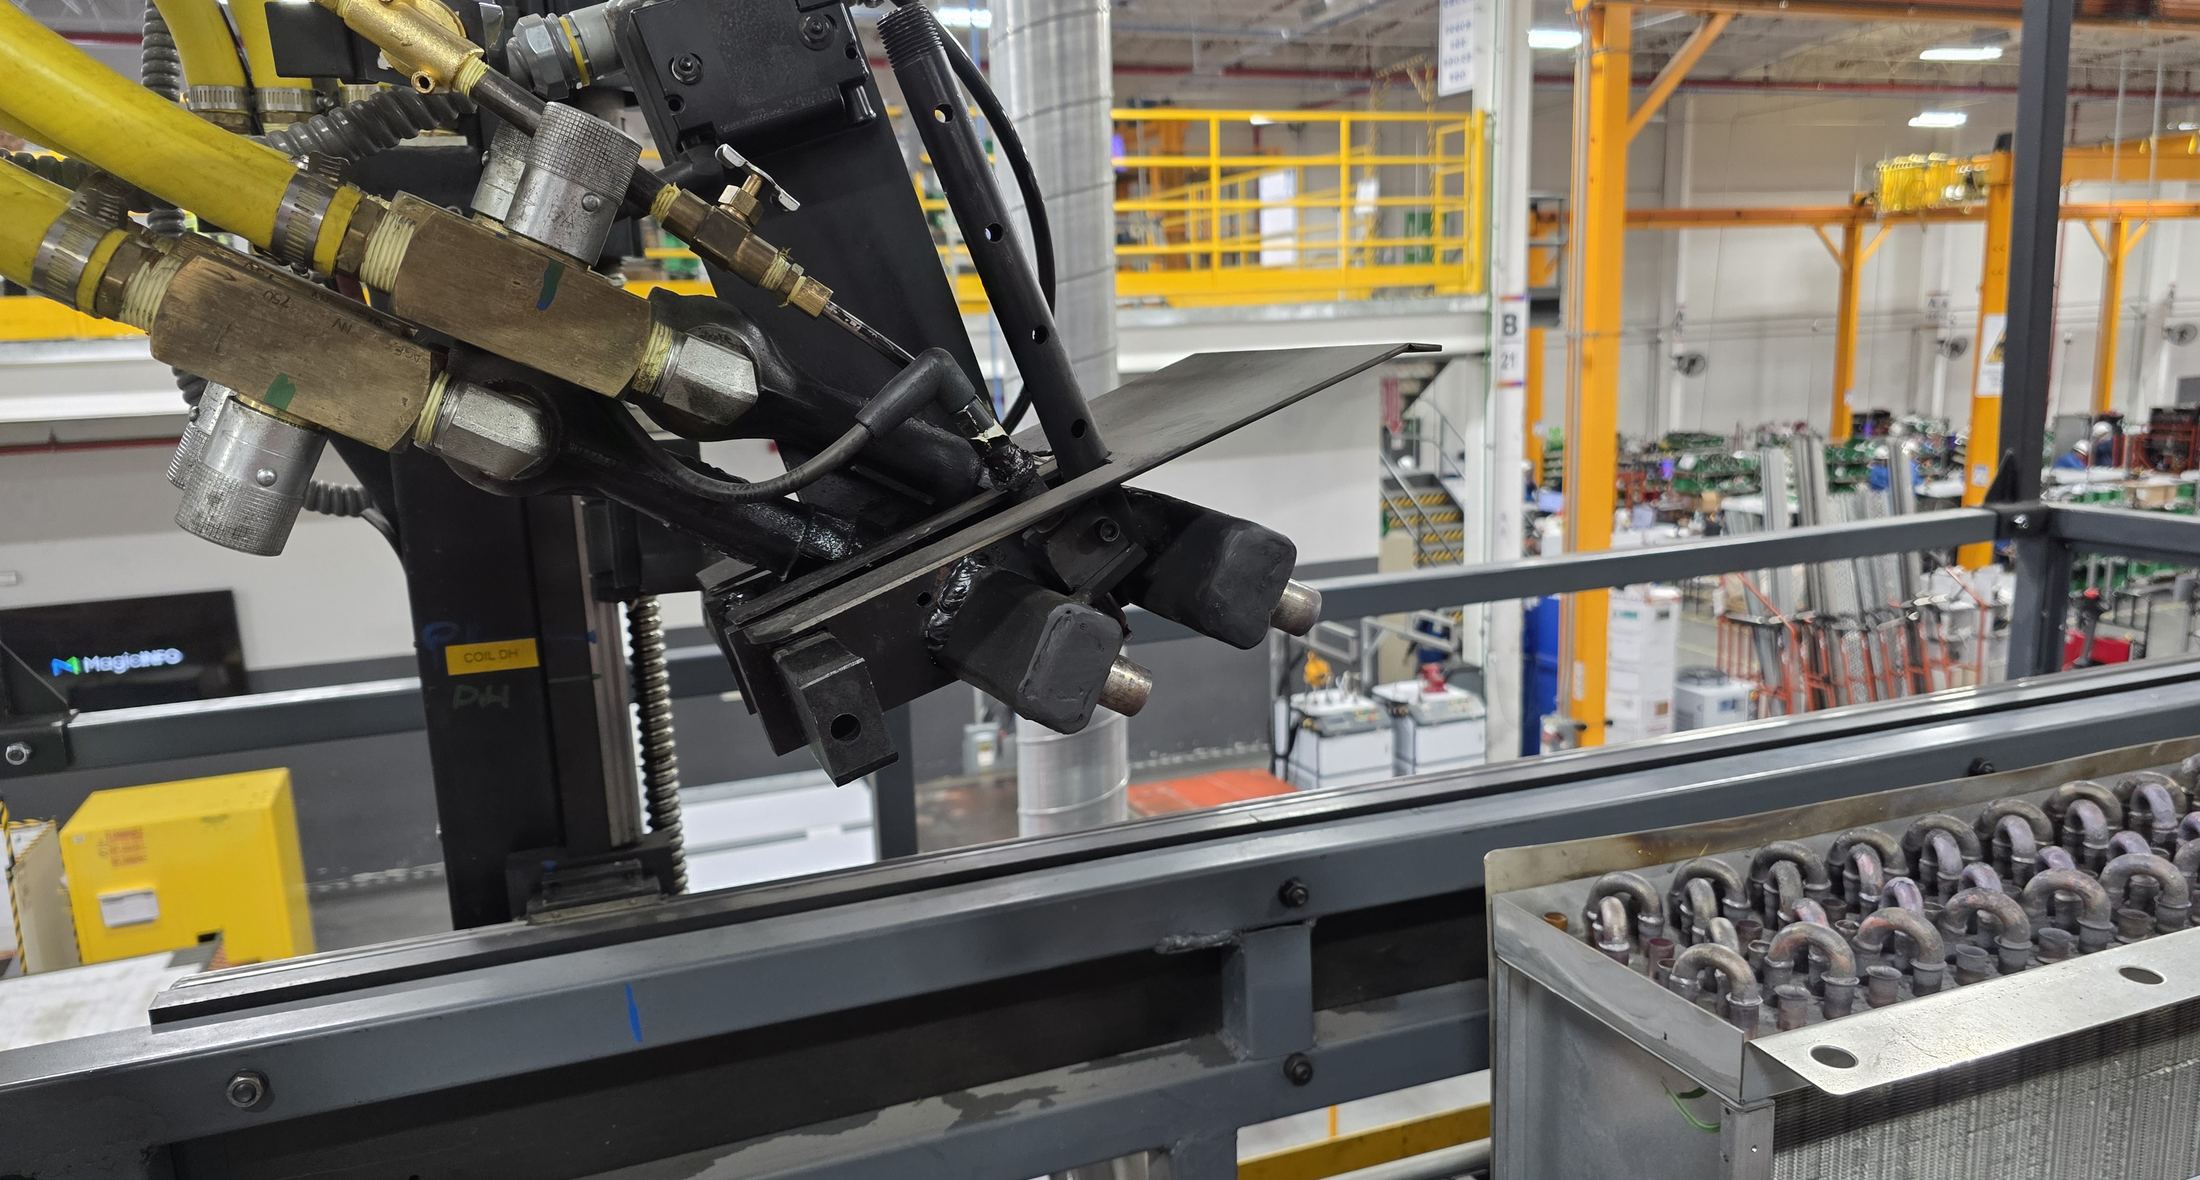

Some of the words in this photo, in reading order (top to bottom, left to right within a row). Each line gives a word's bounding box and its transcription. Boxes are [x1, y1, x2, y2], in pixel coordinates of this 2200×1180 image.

[1503, 314, 1517, 336] B
[1500, 351, 1515, 370] 21
[83, 648, 183, 674] MagicINFO
[463, 650, 497, 664] COIL
[498, 647, 519, 660] DH
